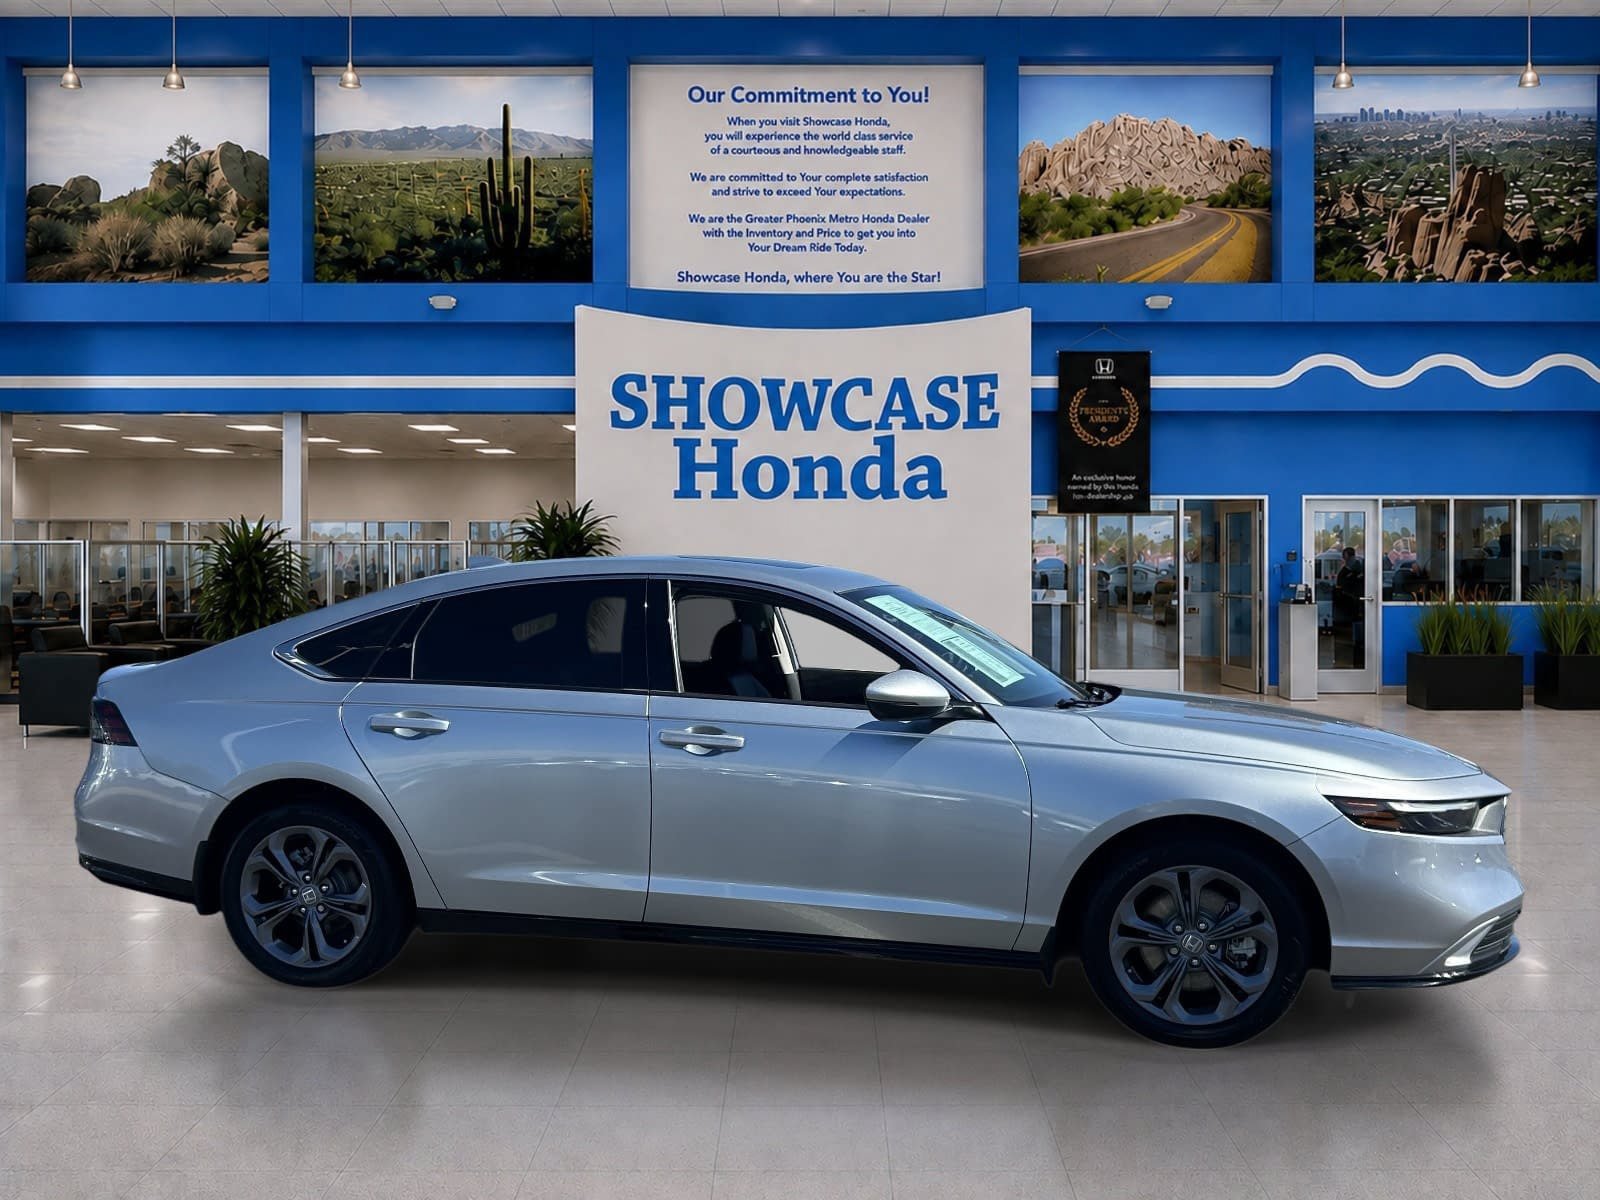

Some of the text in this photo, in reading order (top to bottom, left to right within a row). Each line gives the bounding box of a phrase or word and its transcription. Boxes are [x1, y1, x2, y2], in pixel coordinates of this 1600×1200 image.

[687, 86, 929, 103] Our Commitment to You!
[727, 116, 890, 128] When you visit Showcase Honda,
[705, 131, 913, 142] you will experience the world class service
[710, 145, 721, 155] of
[722, 147, 729, 155] a
[731, 145, 781, 155] courteous
[783, 145, 801, 155] and
[881, 144, 906, 155] staff.
[690, 172, 929, 184] We are committed to Your complete satisfaction
[711, 187, 906, 199] and strive to exceed Your expectations.
[688, 214, 706, 223] We
[726, 214, 743, 223] the
[745, 214, 784, 223] Greater
[786, 214, 826, 223] Phoenix
[828, 214, 860, 223] Metro
[862, 214, 895, 223] Honda
[897, 214, 930, 223] Dealer
[703, 228, 916, 240] with the Inventory and Price to get you into
[748, 242, 867, 254] Your Dream Ride Today.
[677, 271, 941, 285] Showcase Honda, where You are the Star!
[610, 373, 1000, 431] SHOWCASE
[672, 434, 948, 500] Honda
